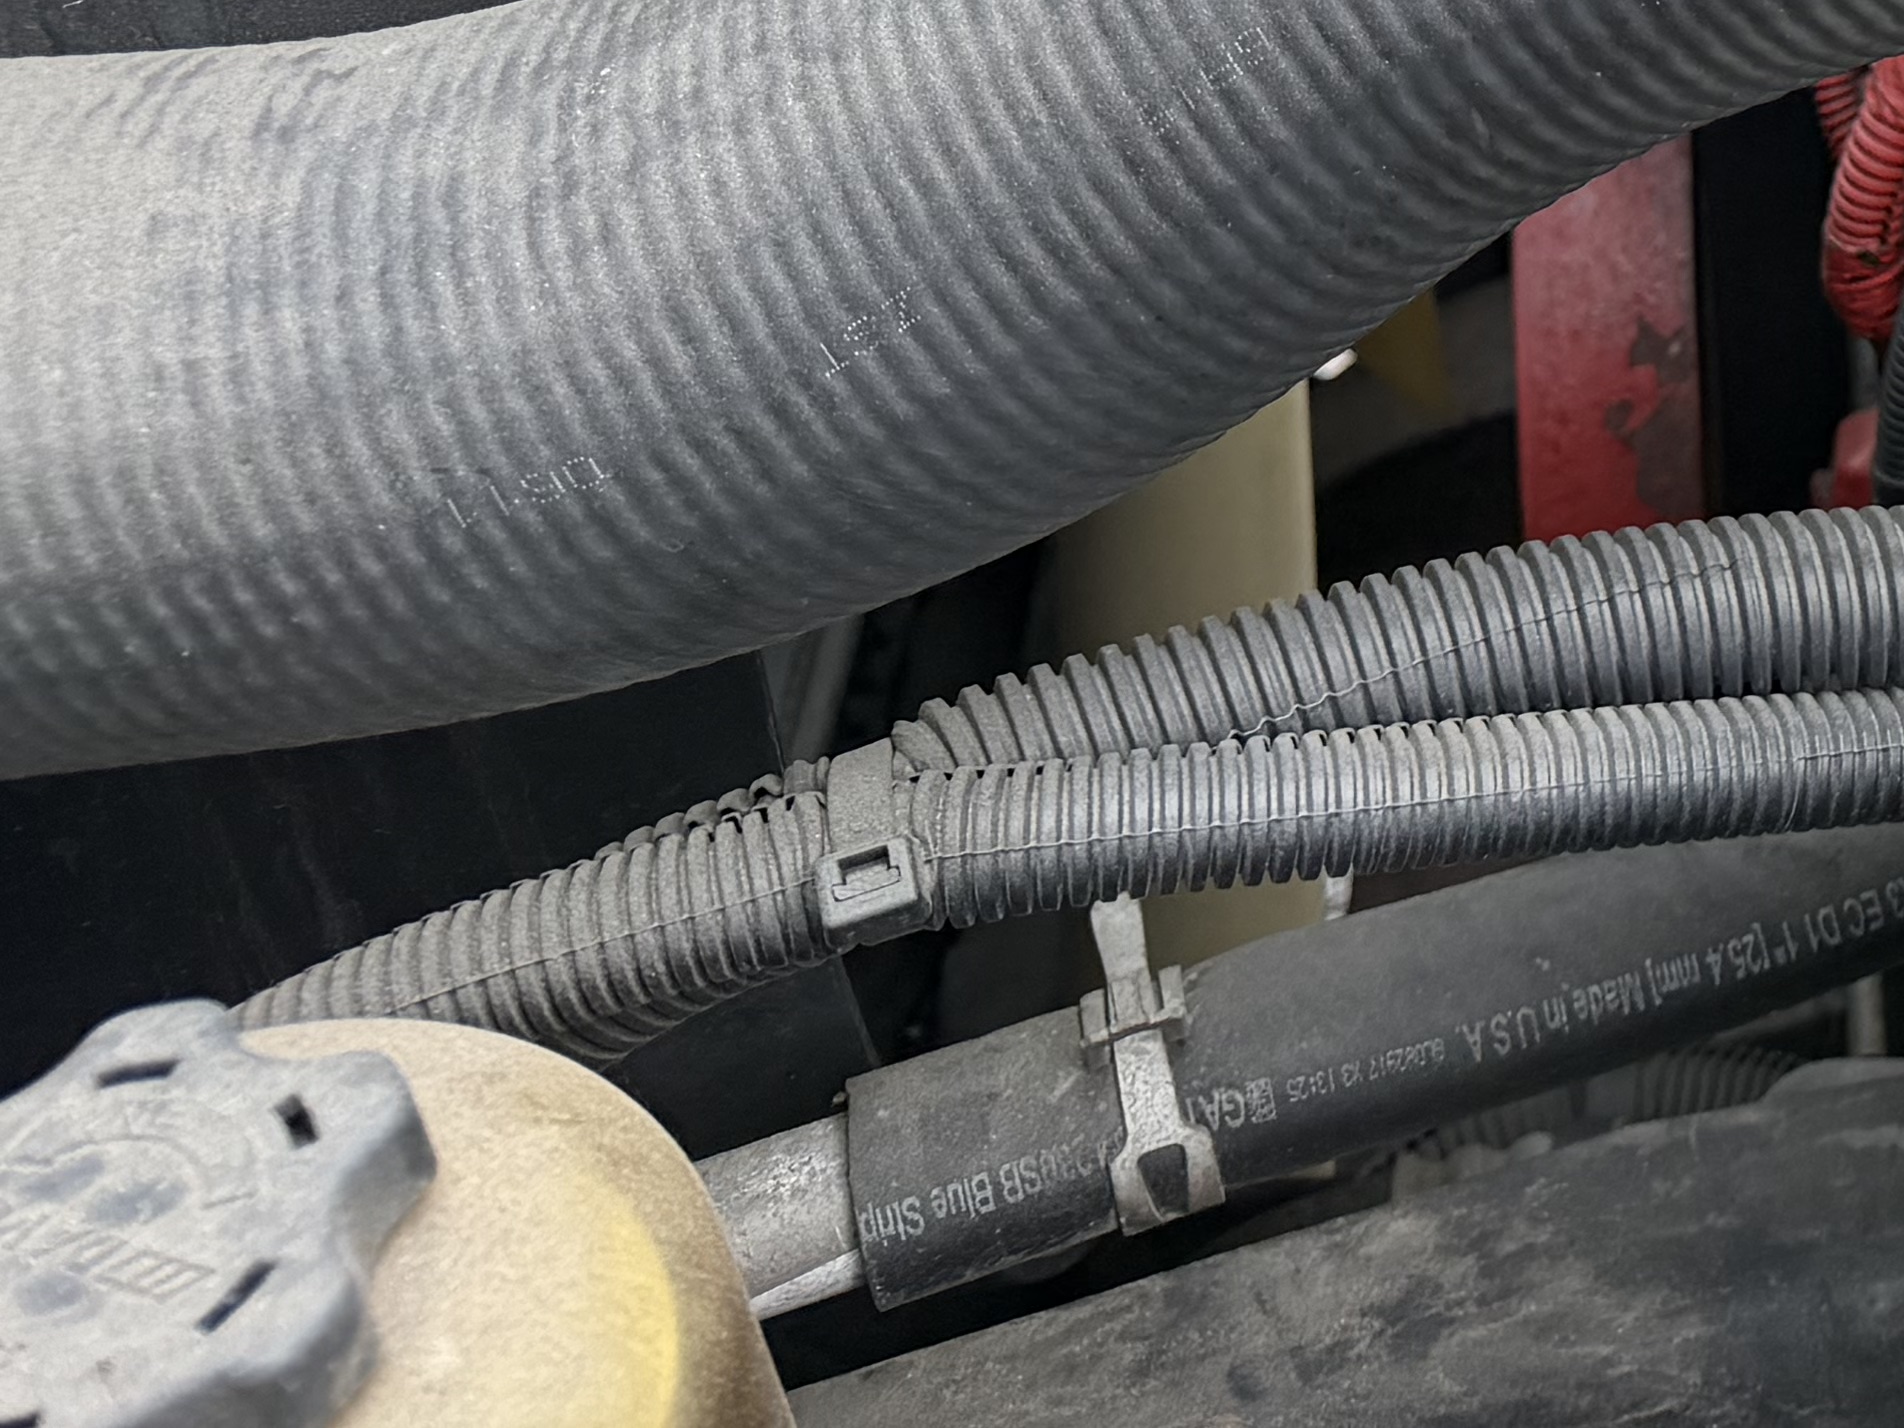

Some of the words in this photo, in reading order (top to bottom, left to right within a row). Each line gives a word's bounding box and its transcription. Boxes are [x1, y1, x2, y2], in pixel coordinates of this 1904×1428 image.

[1842, 889, 1882, 935] EC
[1705, 922, 1770, 985] [25.4
[1572, 973, 1644, 1020] Made
[1644, 953, 1700, 1005] mm]
[1454, 1006, 1540, 1061] U.S.A.
[1542, 997, 1569, 1031] in
[930, 1171, 995, 1218] Blue
